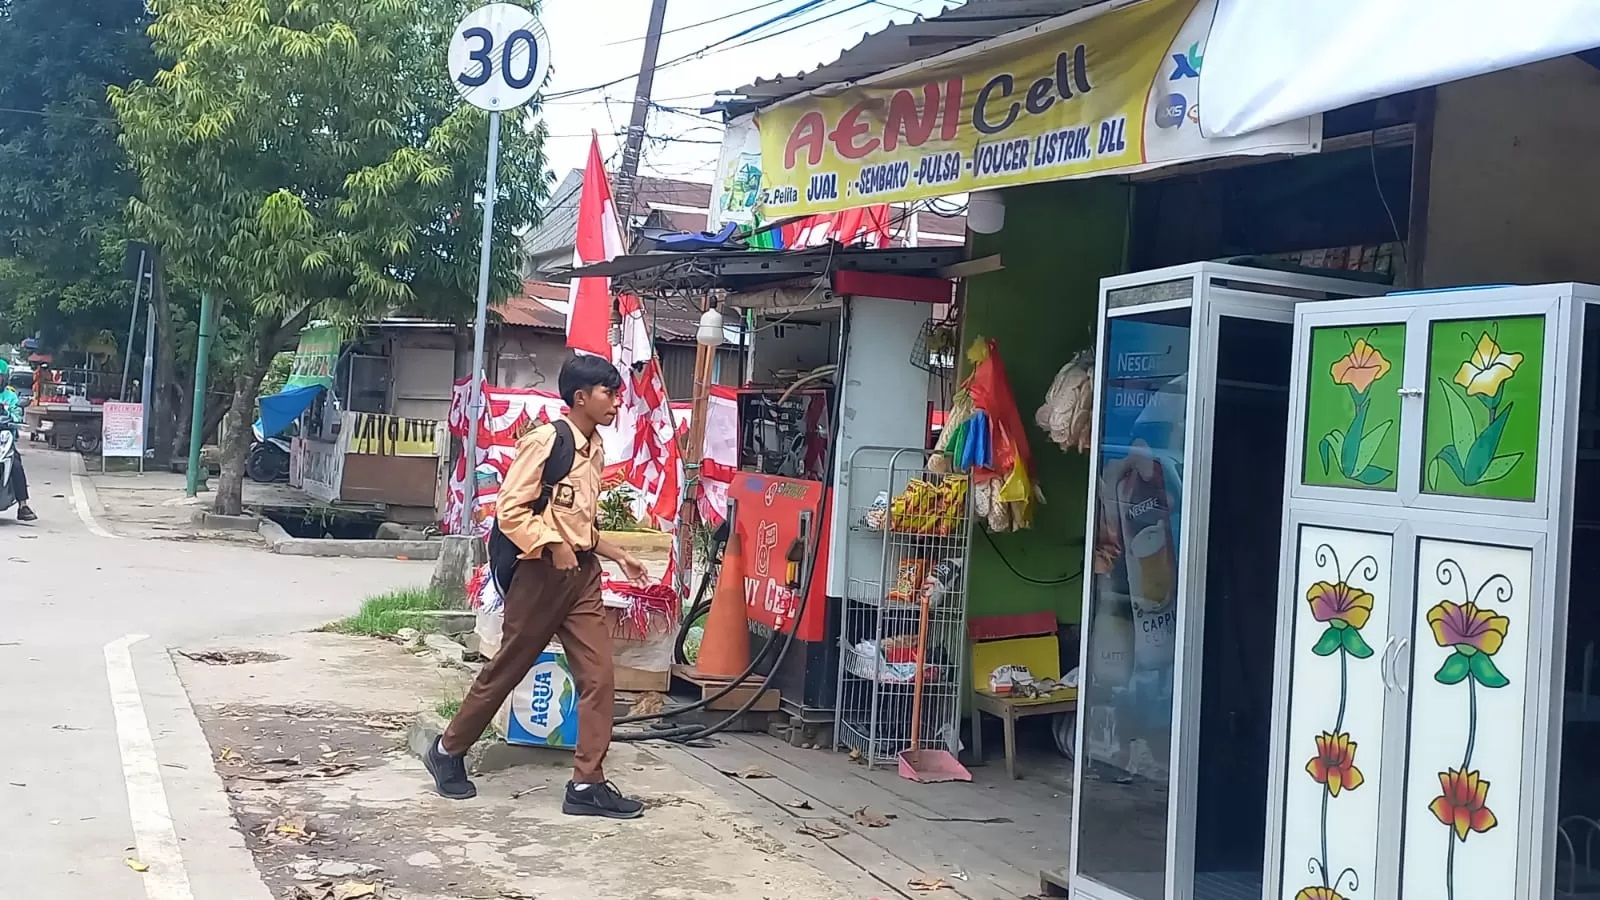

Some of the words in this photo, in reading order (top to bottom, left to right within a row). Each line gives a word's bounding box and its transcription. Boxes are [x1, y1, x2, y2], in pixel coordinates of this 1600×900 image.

[458, 27, 538, 89] 30
[784, 78, 963, 169] AENI
[973, 45, 1091, 134] Cell
[807, 174, 838, 202] JUAL
[1033, 126, 1092, 166] LISTRIK,
[1098, 118, 1126, 155] DLL
[530, 671, 554, 728] AQUA
